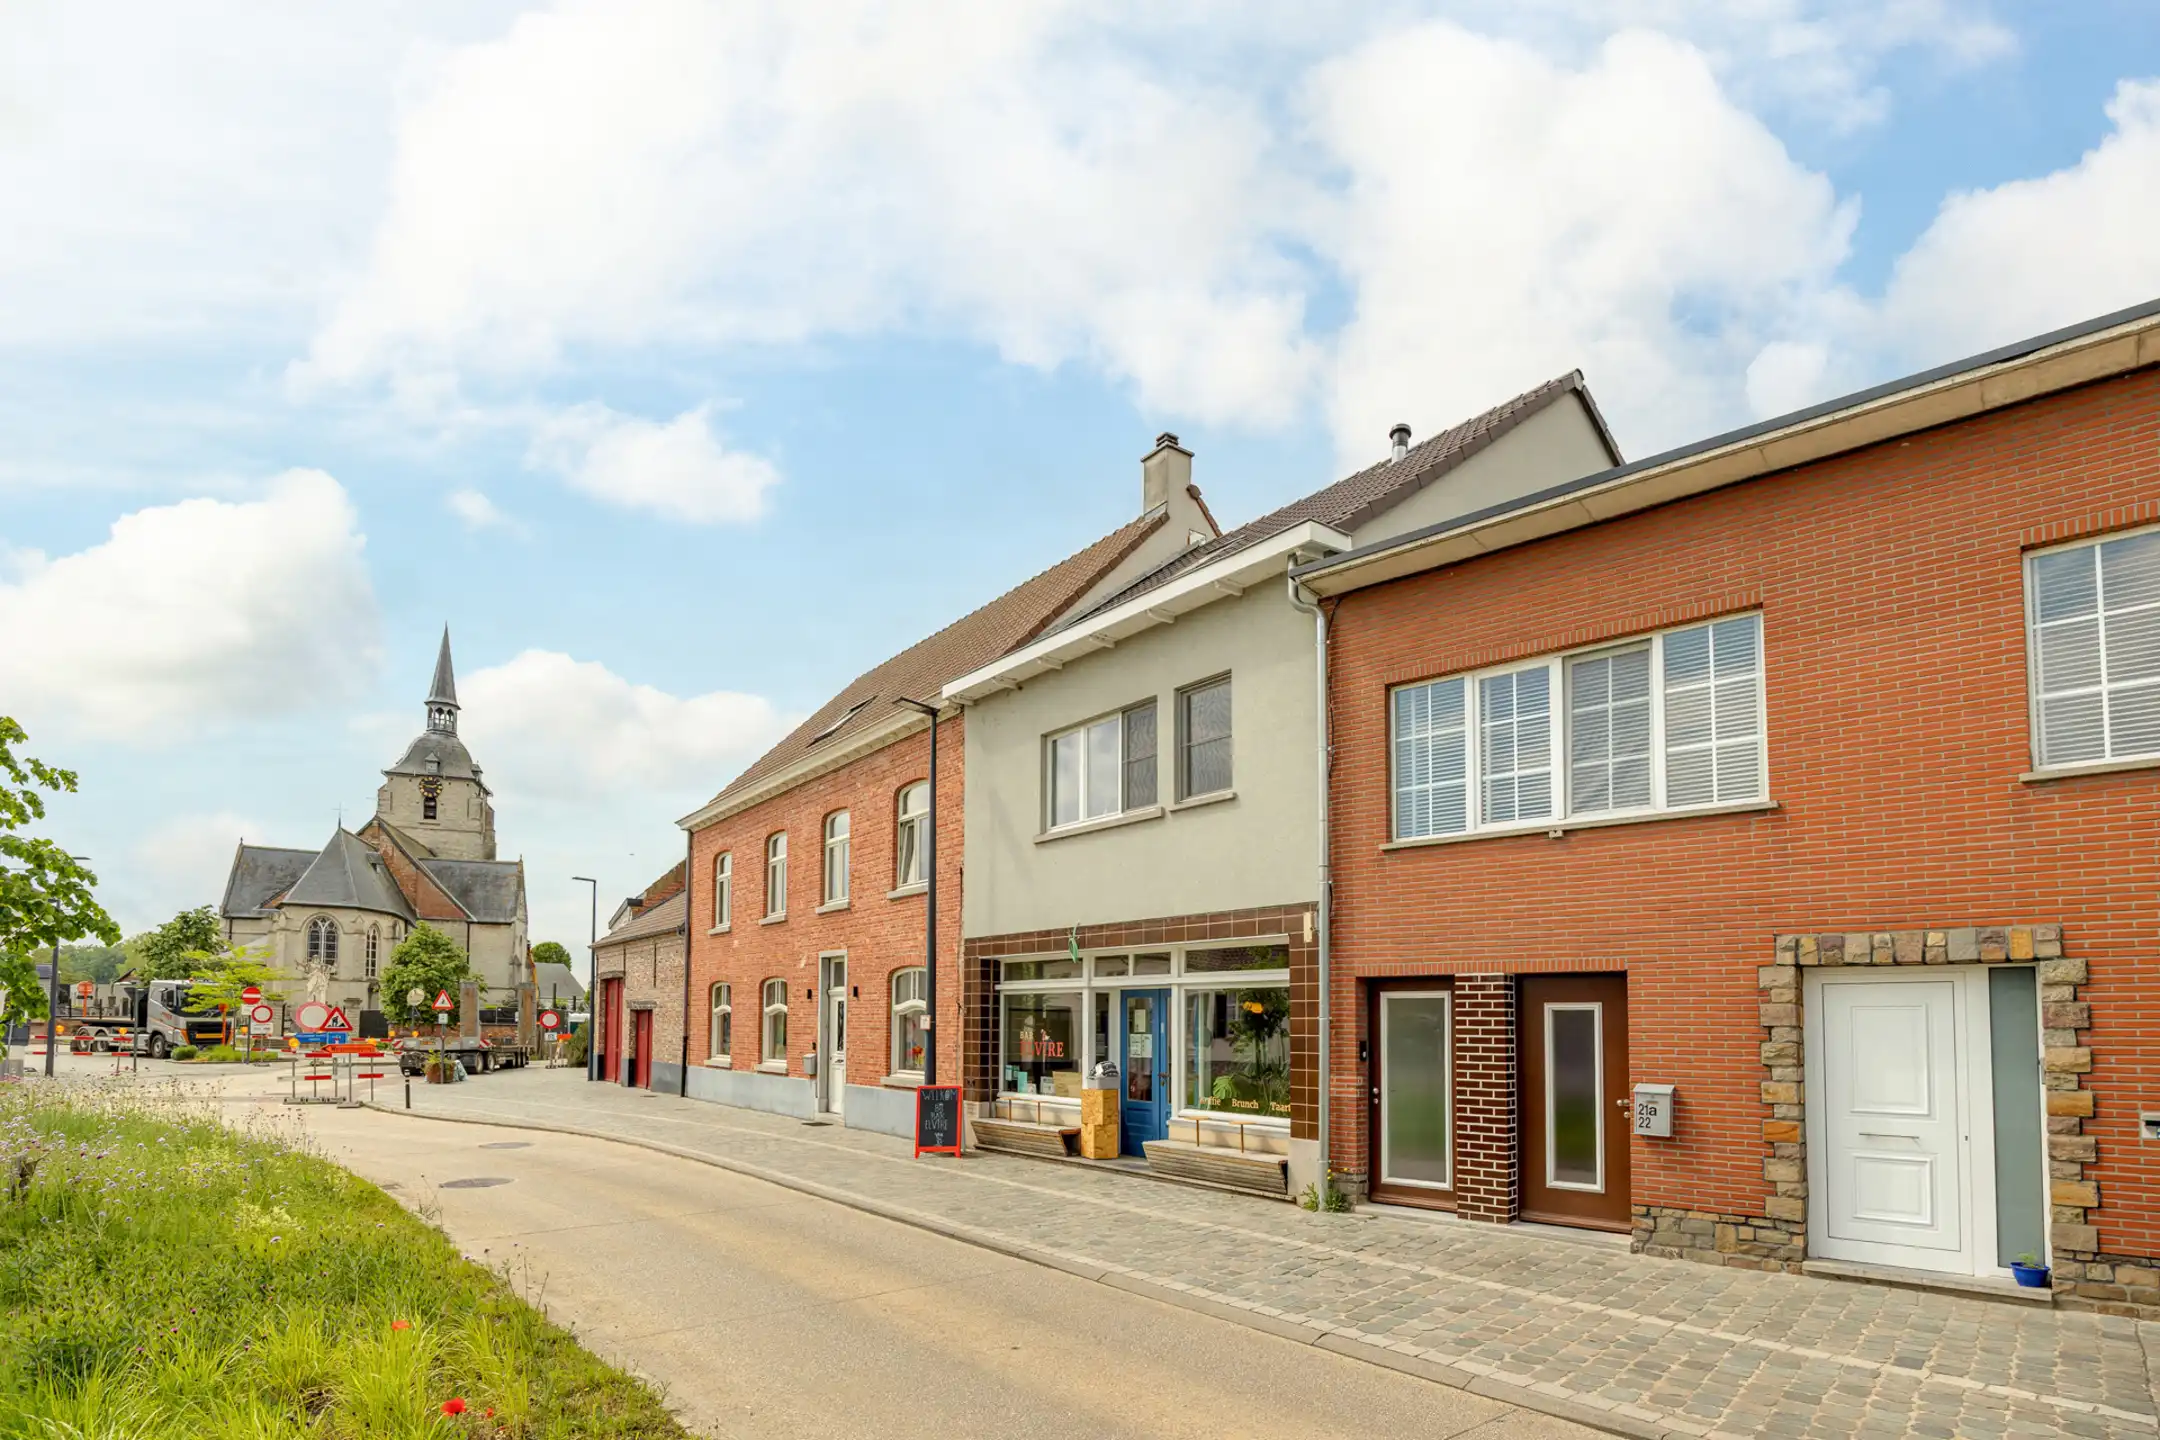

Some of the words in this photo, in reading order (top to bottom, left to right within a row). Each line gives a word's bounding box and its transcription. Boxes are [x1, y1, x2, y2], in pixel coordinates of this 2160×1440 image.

[1020, 1031, 1034, 1040] BAR
[1020, 1041, 1064, 1057] ELVIRE
[1232, 1098, 1259, 1109] Brunch
[1638, 1104, 1657, 1116] 21a
[1638, 1117, 1651, 1128] 22
